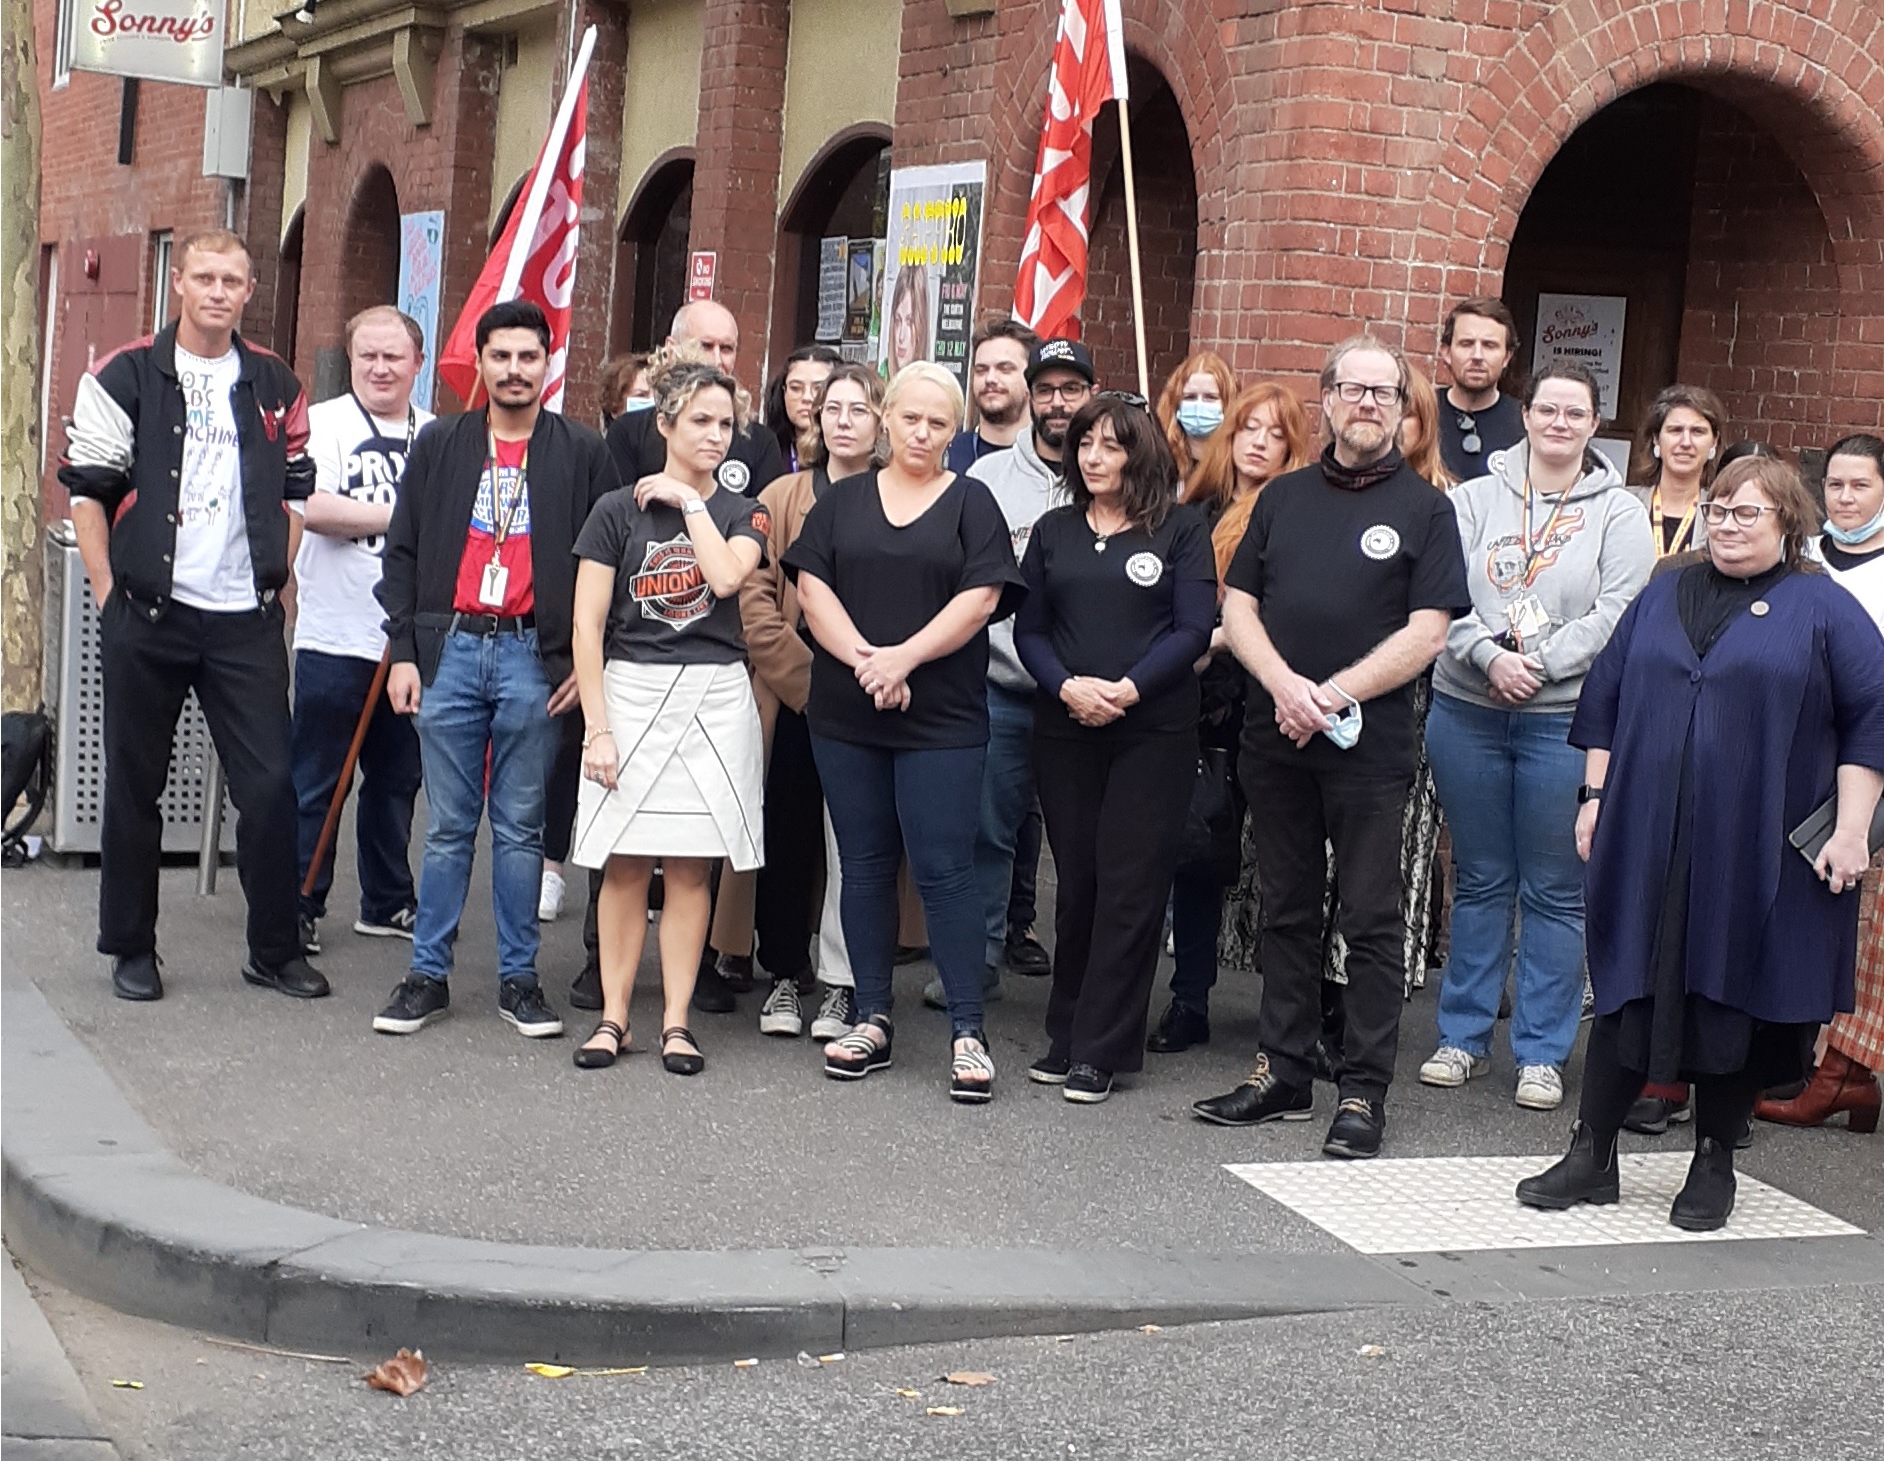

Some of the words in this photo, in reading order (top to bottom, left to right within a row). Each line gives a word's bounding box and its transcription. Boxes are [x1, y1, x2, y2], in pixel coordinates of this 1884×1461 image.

[1542, 320, 1598, 344] Sonny's
[1553, 346, 1562, 355] IS
[1564, 347, 1602, 357] HIRING!
[181, 371, 213, 391] OT
[186, 424, 239, 448] ACHINE
[340, 451, 407, 491] PRO
[636, 566, 702, 598] UNIONI
